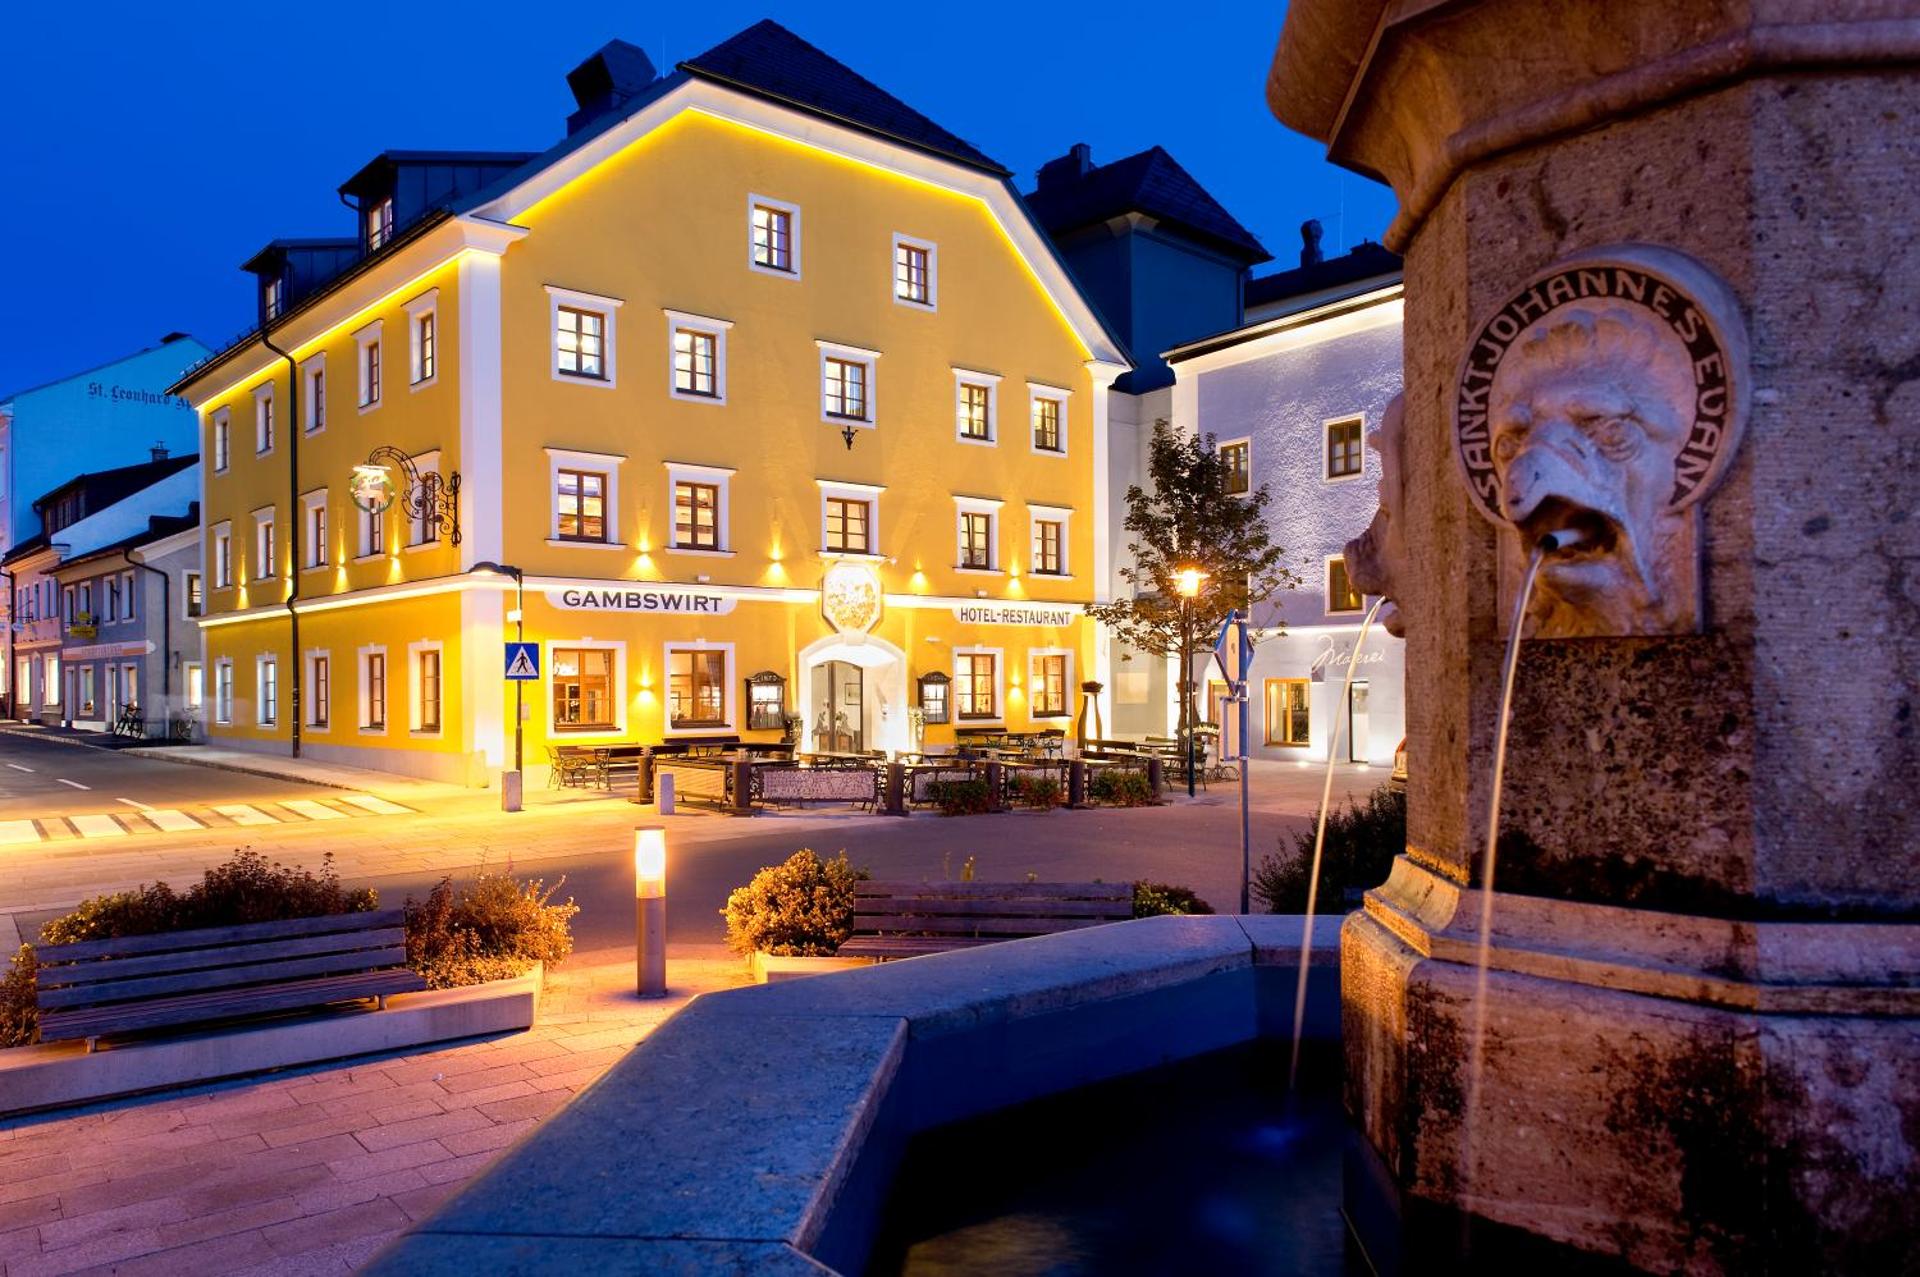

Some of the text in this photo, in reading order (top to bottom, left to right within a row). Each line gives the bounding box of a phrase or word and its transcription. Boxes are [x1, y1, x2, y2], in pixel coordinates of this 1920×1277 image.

[1478, 269, 1704, 364] JOHANNES
[1459, 360, 1502, 507] SANKT
[563, 590, 722, 612] GAMBSWIRT
[960, 607, 1070, 625] HOTEL-RESTAURANT
[1312, 635, 1385, 673] Maerei
